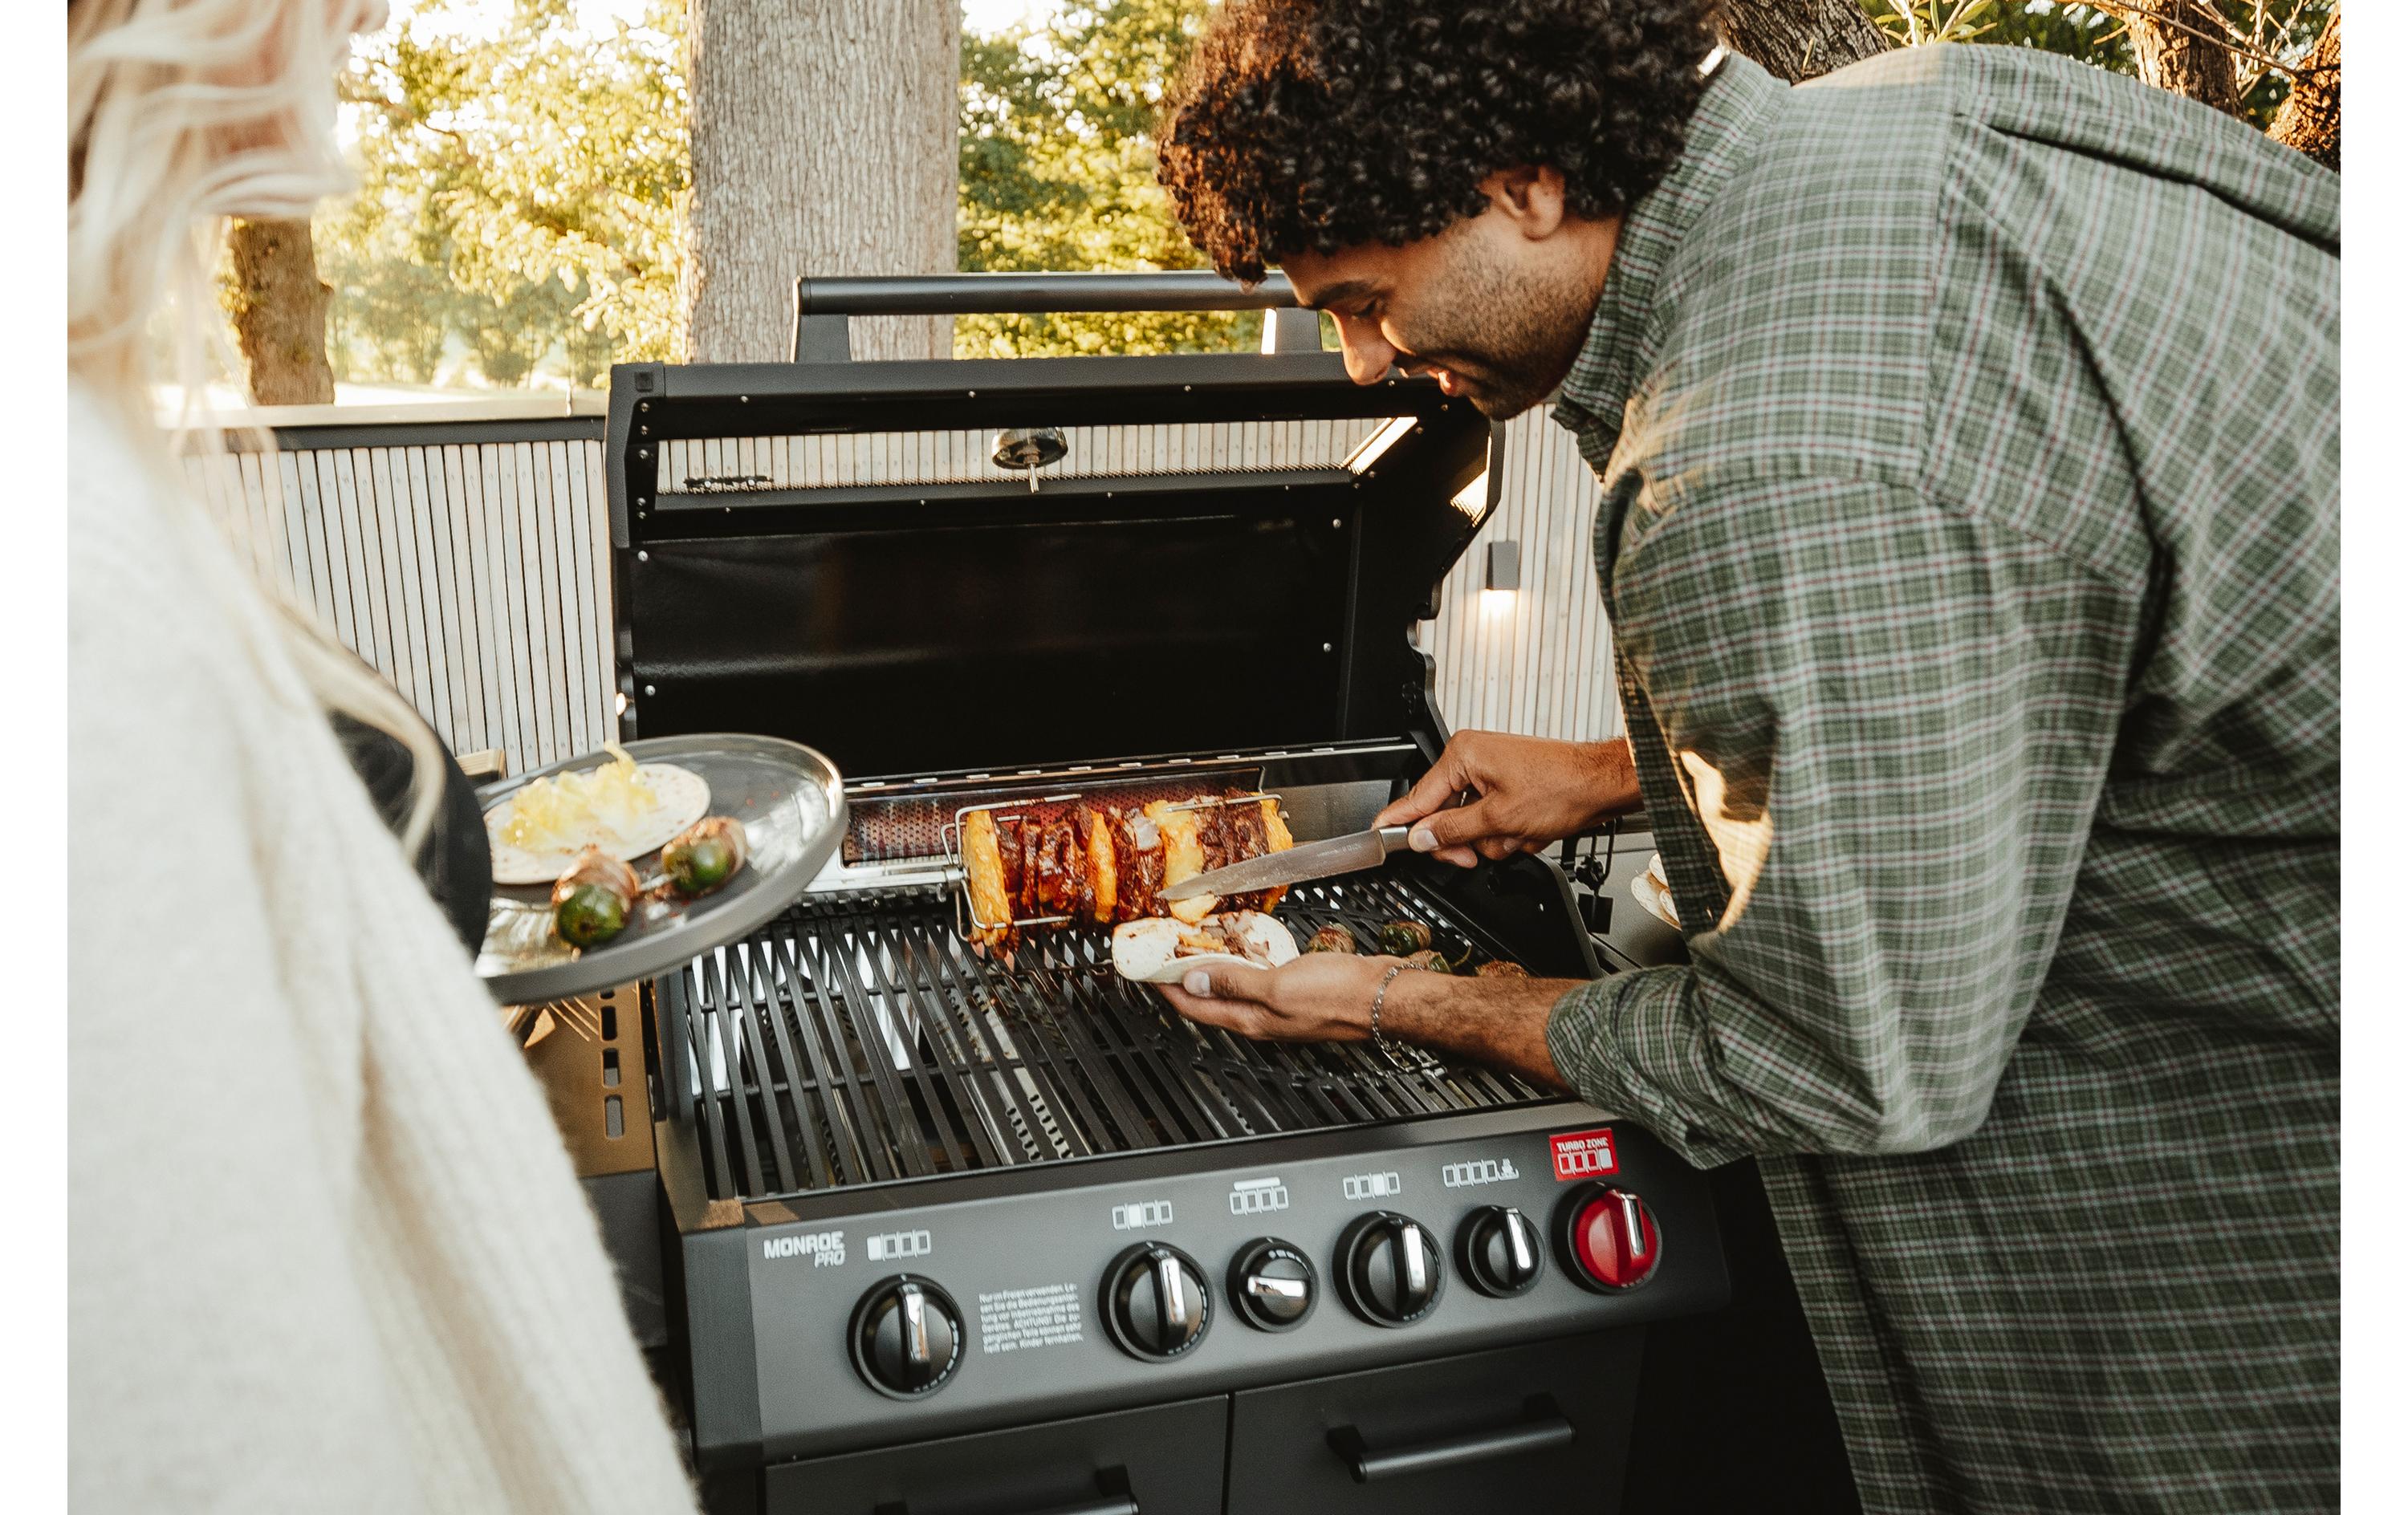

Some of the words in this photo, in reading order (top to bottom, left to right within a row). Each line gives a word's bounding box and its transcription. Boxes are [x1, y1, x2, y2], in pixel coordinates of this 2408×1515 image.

[1556, 1140, 1585, 1152] TURBO
[1585, 1136, 1609, 1149] ZONE
[763, 1230, 844, 1259] MONROE
[814, 1249, 846, 1268] PRO
